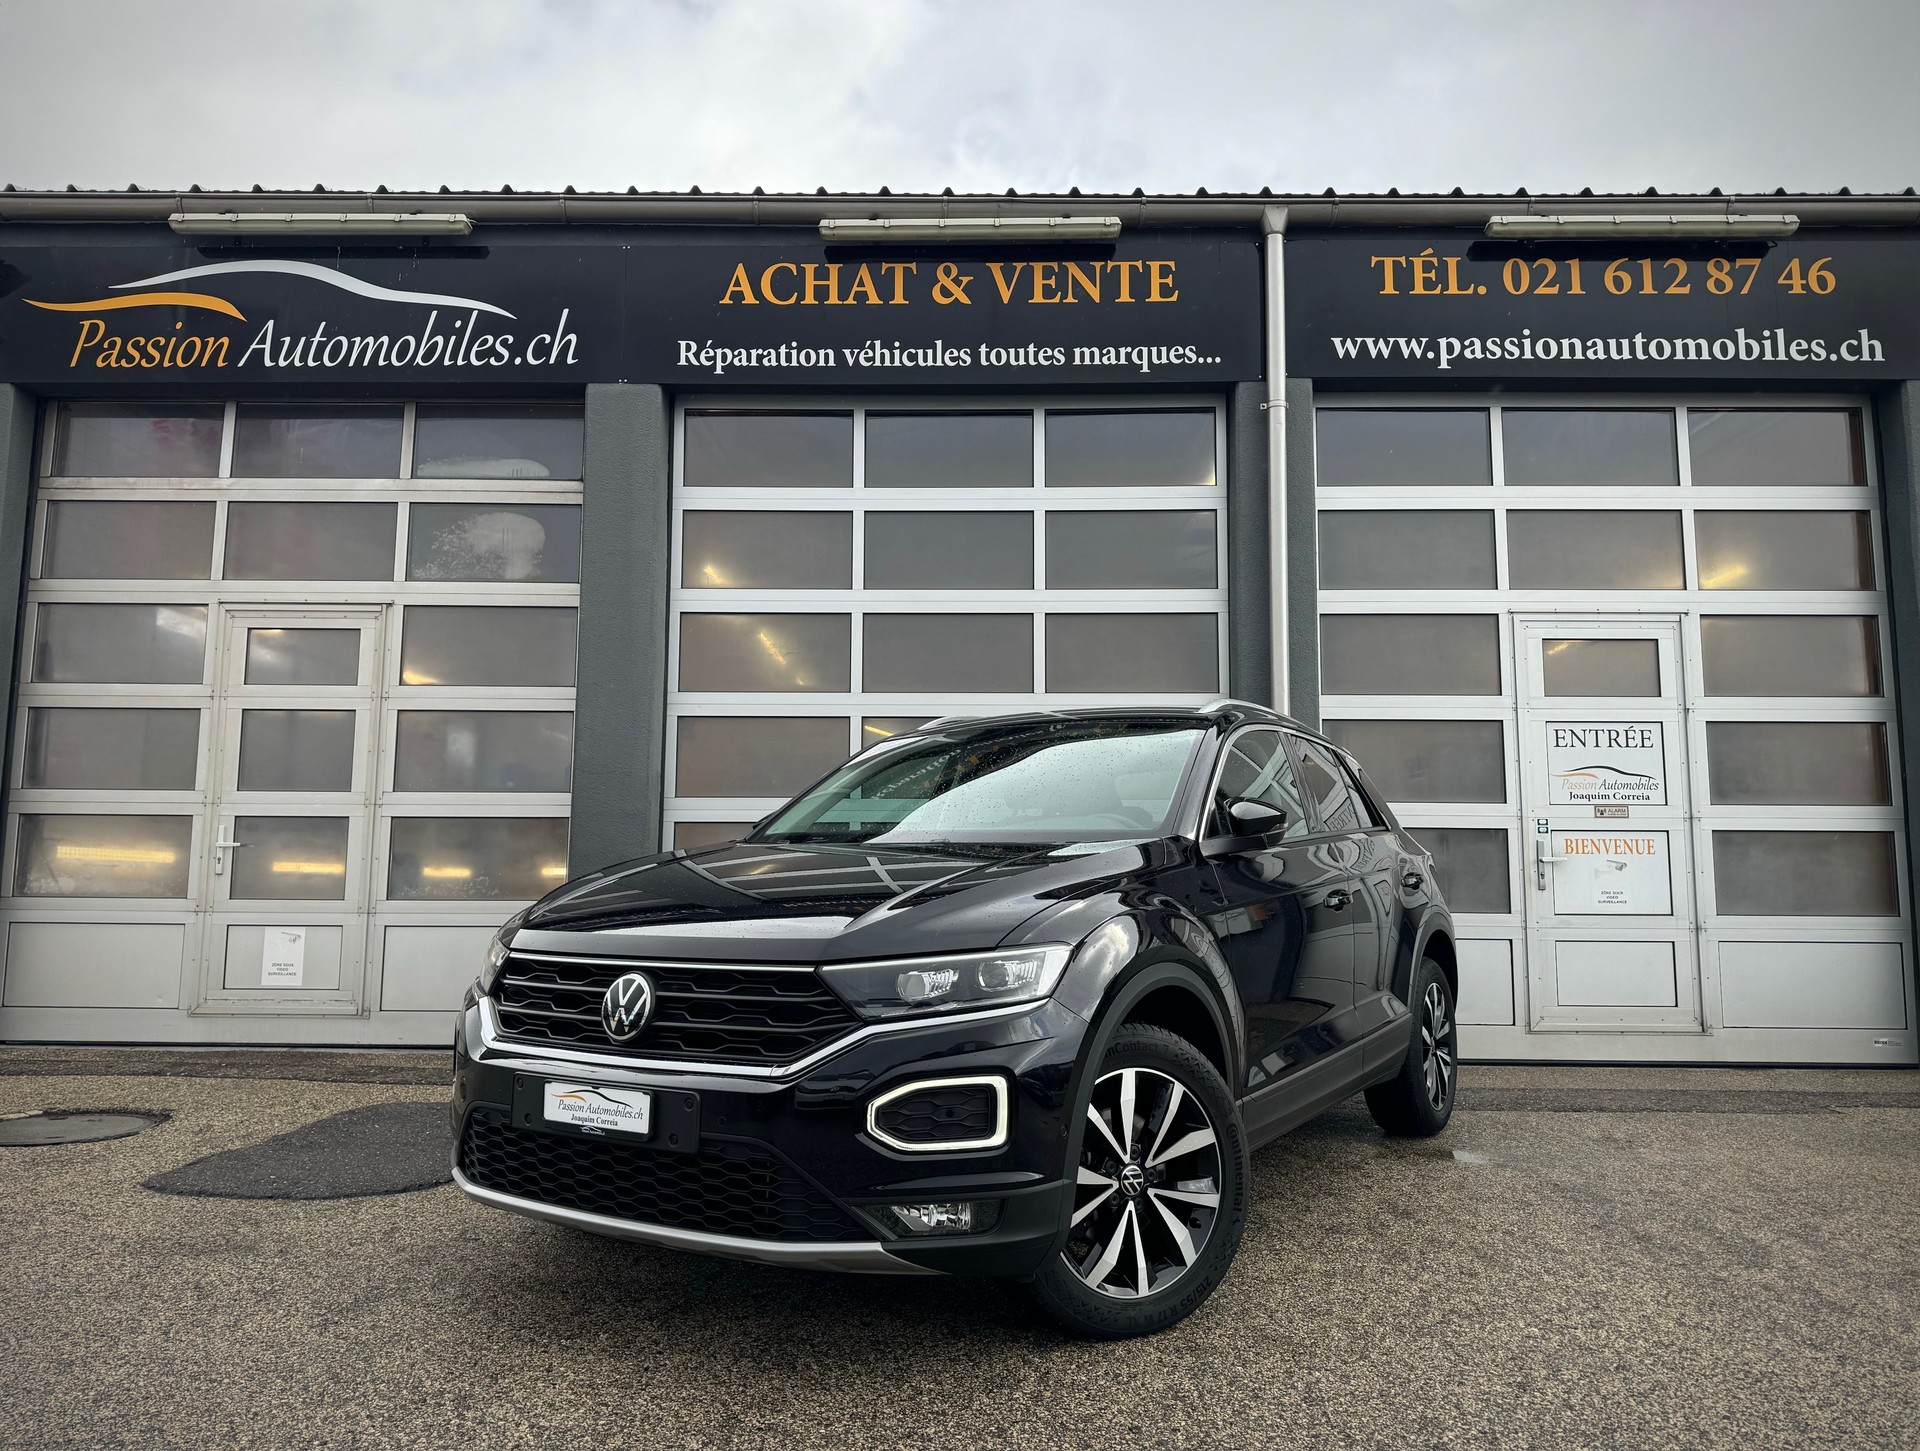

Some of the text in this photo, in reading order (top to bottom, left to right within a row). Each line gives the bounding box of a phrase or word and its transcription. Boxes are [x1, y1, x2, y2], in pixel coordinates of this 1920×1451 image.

[719, 259, 1180, 306] ACHAT & VENTE
[1371, 247, 1837, 296] TÉL. 021 612 87 46
[68, 308, 579, 369] Passion Automobiles.ch
[1331, 328, 1886, 370] www.passionautomobiles.ch
[677, 340, 1222, 375] Réparation véhicules toutes marques...
[1553, 725, 1654, 749] ENTRÉE
[1561, 777, 1660, 791] Passion Automobiles
[1569, 791, 1650, 802] Joaquim Correia
[1564, 838, 1656, 855] BIENVENUE
[557, 1099, 644, 1121] Passion Automobiles.ch
[570, 1113, 619, 1127] Joaquim Correia
